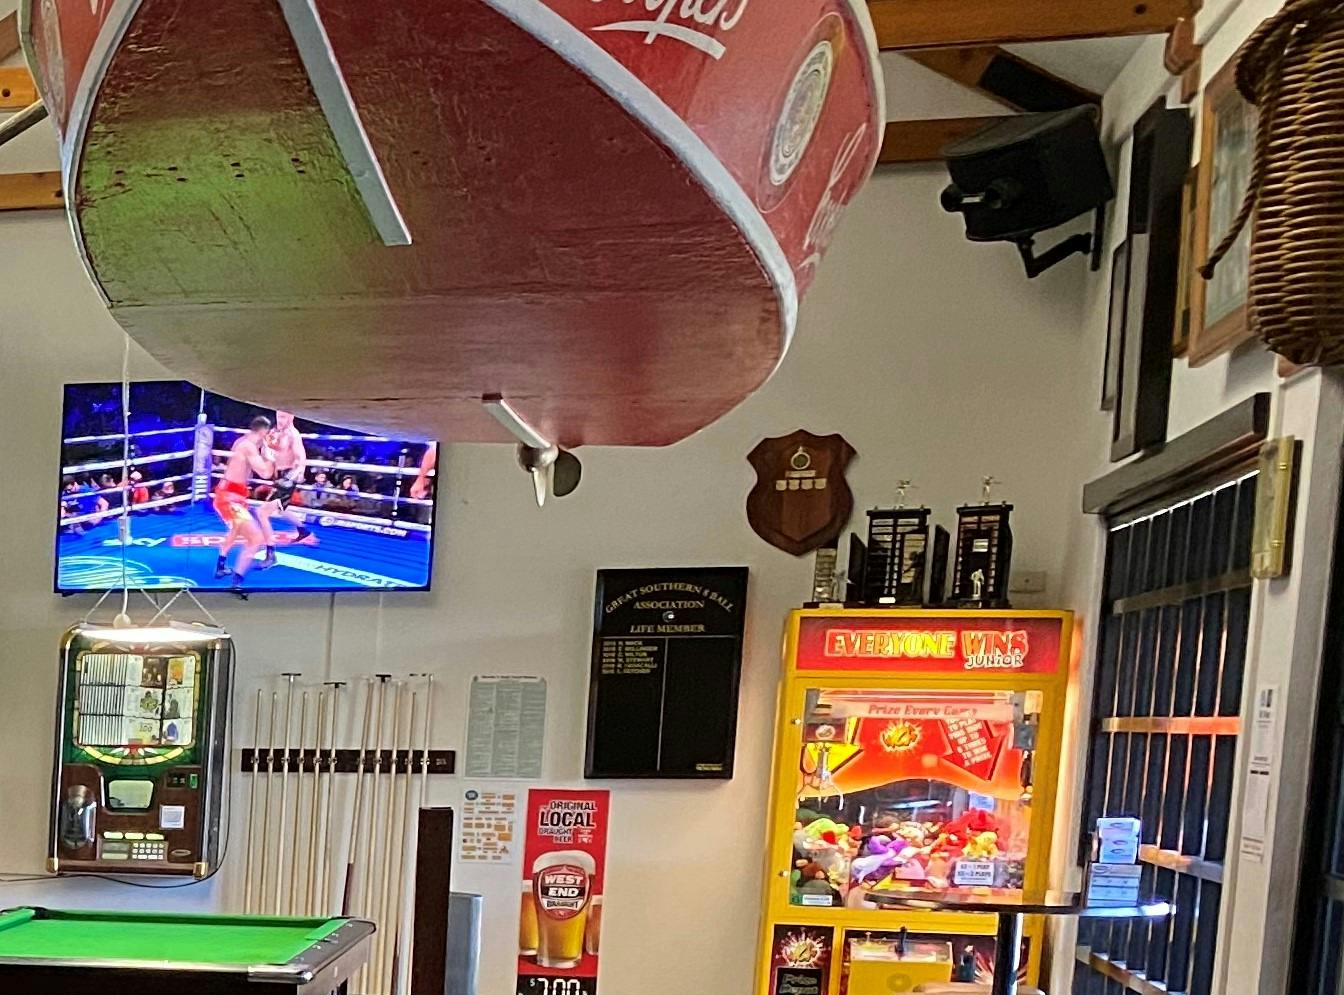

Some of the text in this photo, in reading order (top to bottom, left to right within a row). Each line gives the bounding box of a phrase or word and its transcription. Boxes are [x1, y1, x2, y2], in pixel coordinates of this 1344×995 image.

[315, 564, 408, 587] HYDRAT
[605, 588, 638, 614] GREAT
[639, 582, 702, 594] SOUTHERN
[708, 591, 734, 613] BALL
[633, 600, 705, 609] ASSOCIATION
[630, 624, 705, 633] LIFE MEMBER
[826, 630, 1028, 657] EVERYONE WINS
[868, 704, 900, 715] Prize
[905, 705, 940, 716] Every
[550, 801, 597, 810] ORIGINAL
[540, 811, 595, 826] LOCAL
[544, 875, 583, 884] WEST
[548, 887, 579, 897] END
